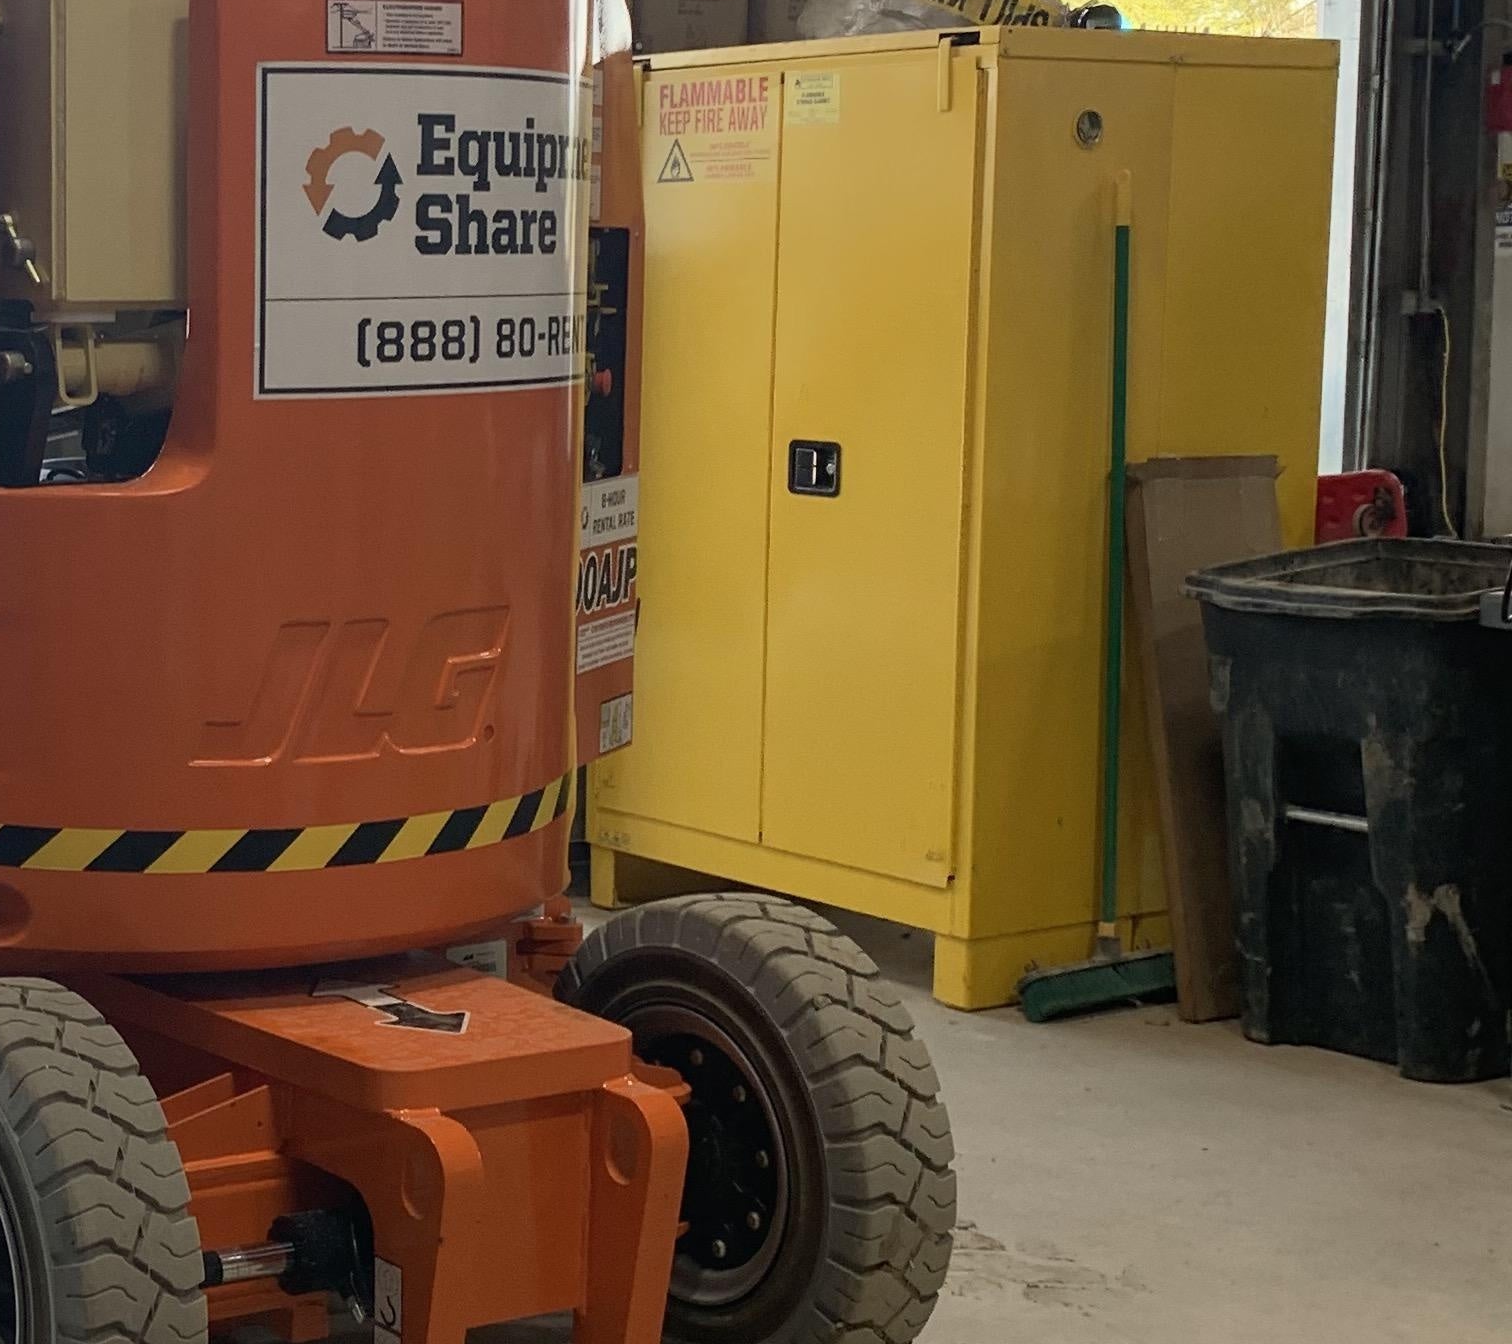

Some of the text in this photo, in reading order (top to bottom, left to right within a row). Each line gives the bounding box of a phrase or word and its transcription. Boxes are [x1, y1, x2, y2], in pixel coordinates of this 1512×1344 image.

[659, 76, 769, 110] FLAMMABLE
[659, 105, 768, 136] KEEP FIRE AWAY
[414, 193, 557, 256] Share
[357, 315, 481, 368] (888)
[592, 509, 635, 533] RENTAL RATE
[188, 605, 511, 768] JLG
